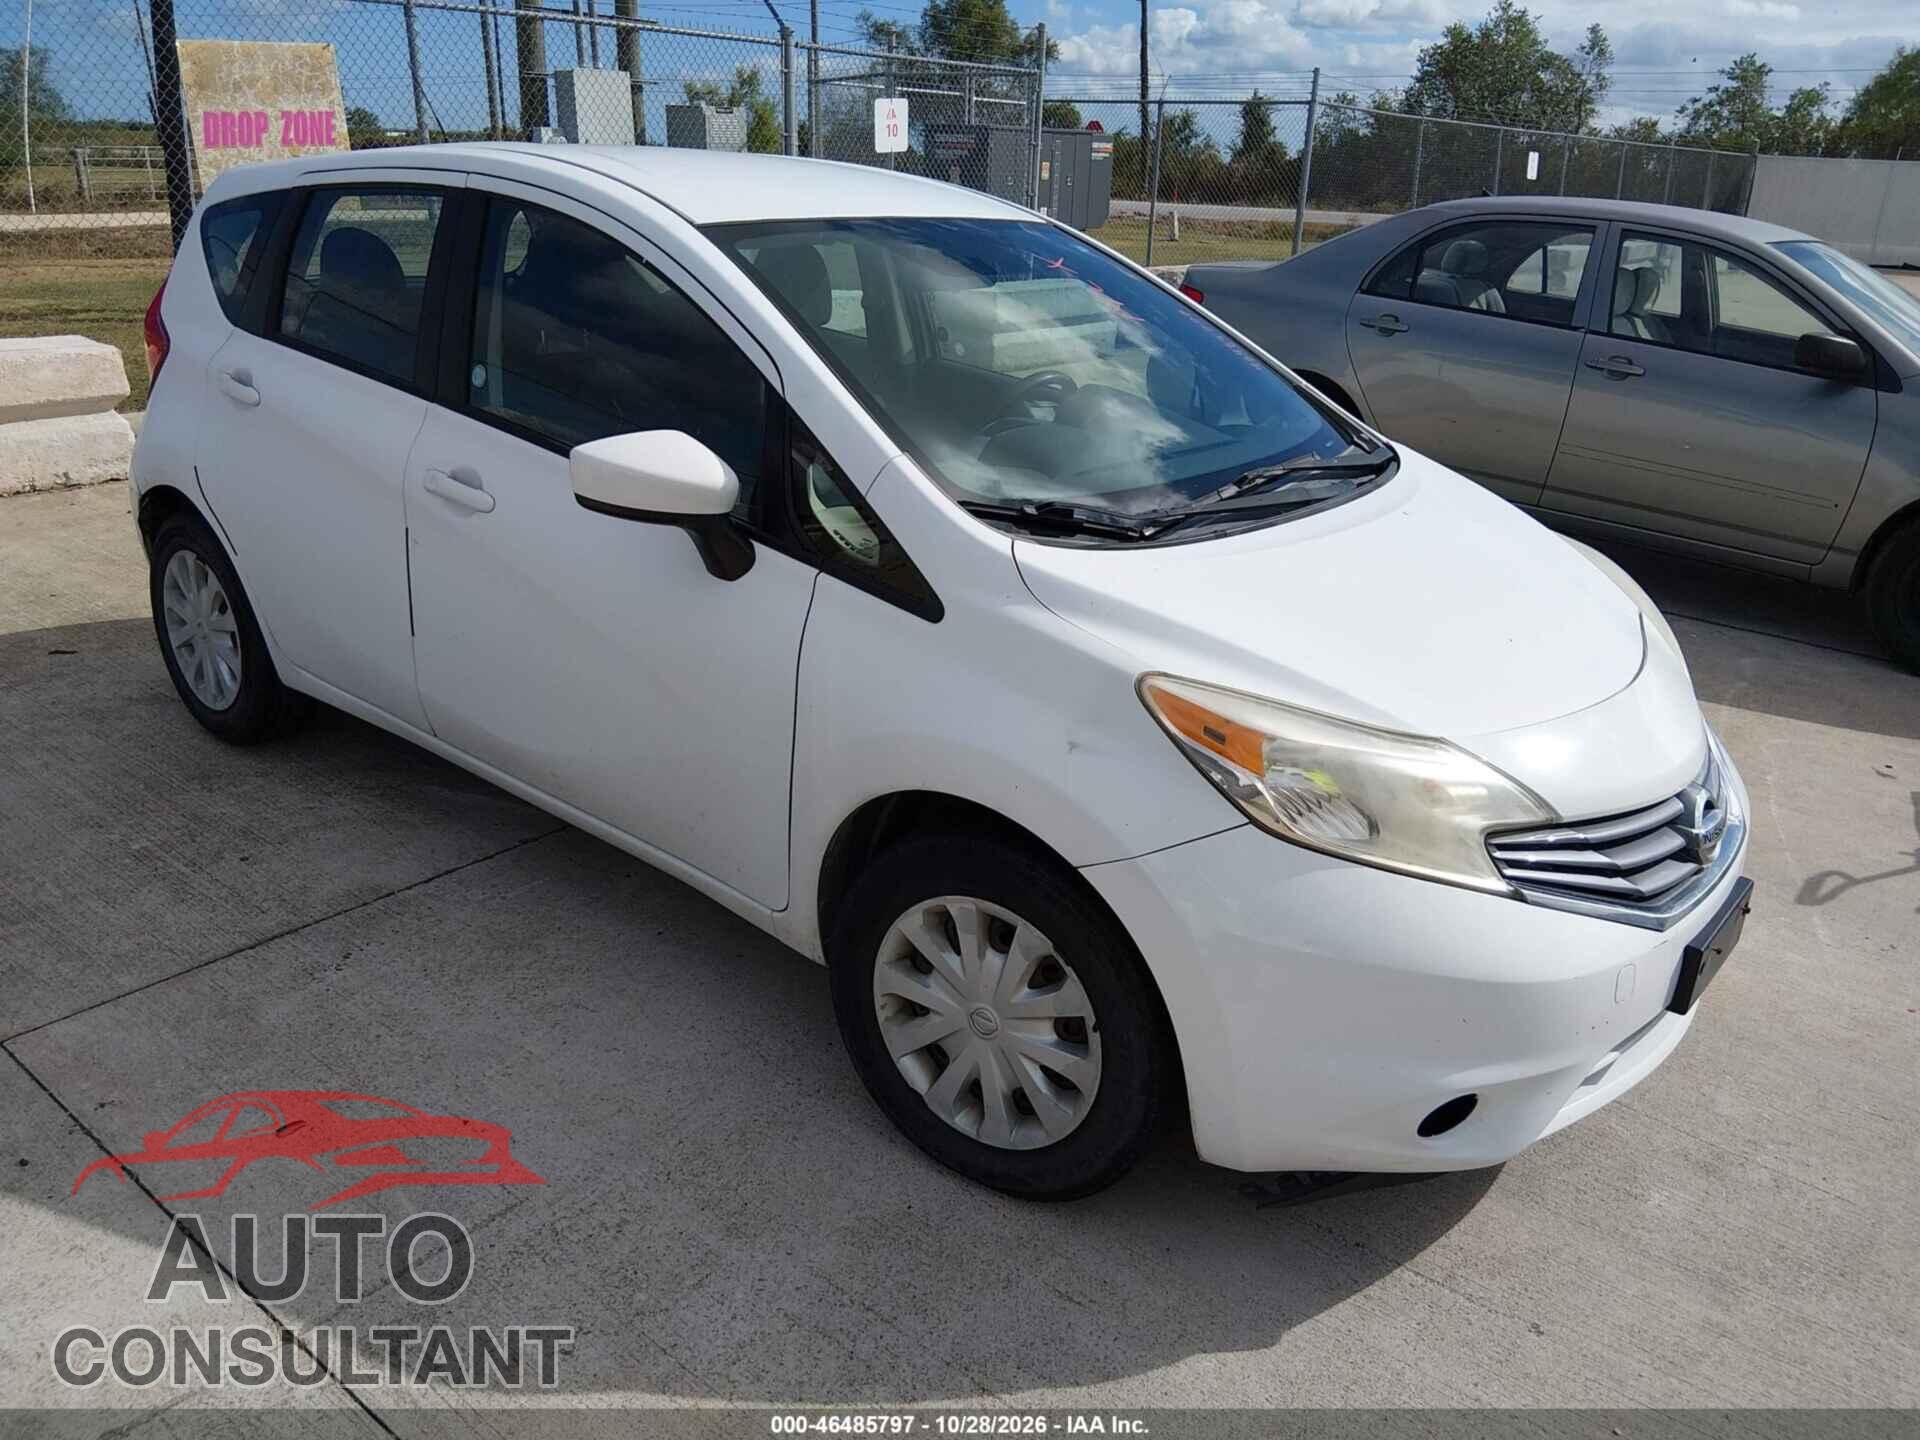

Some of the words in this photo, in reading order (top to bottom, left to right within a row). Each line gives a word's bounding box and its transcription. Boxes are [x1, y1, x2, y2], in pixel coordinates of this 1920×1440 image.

[203, 111, 268, 148] DROP
[279, 111, 336, 147] ZONE
[886, 123, 898, 137] 10
